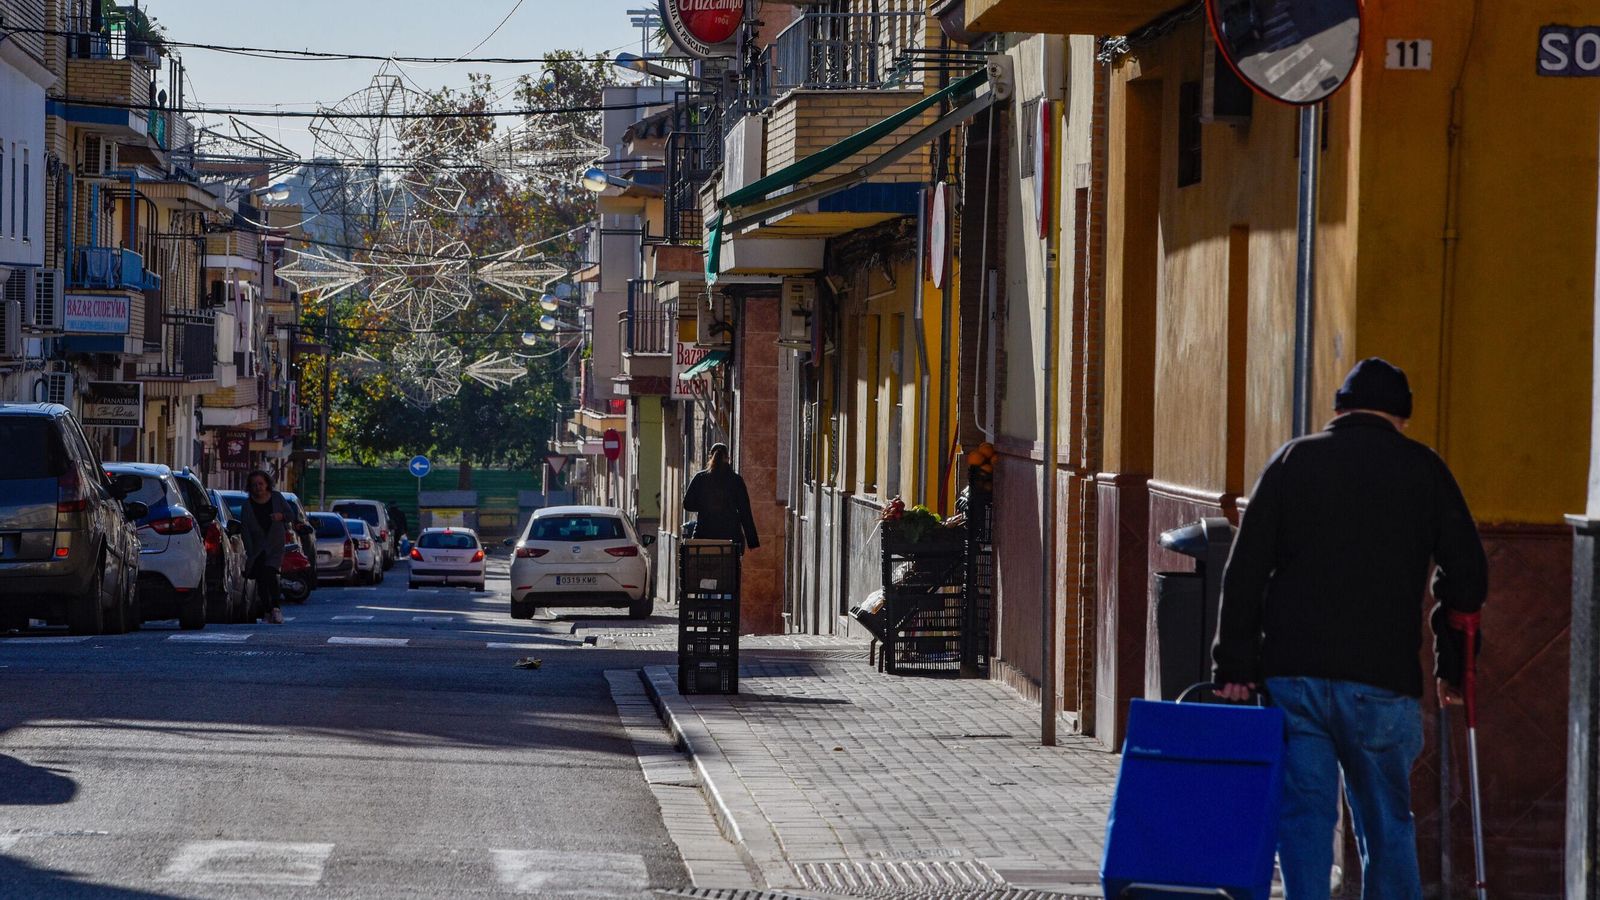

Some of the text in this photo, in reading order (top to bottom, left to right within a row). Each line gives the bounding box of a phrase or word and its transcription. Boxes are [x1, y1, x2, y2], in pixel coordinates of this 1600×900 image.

[674, 21, 682, 33] EL
[680, 31, 710, 55] PESCAITO
[1395, 41, 1419, 67] 11
[1540, 33, 1600, 71] SO
[66, 299, 92, 318] BAZAR
[561, 576, 581, 584] 0319
